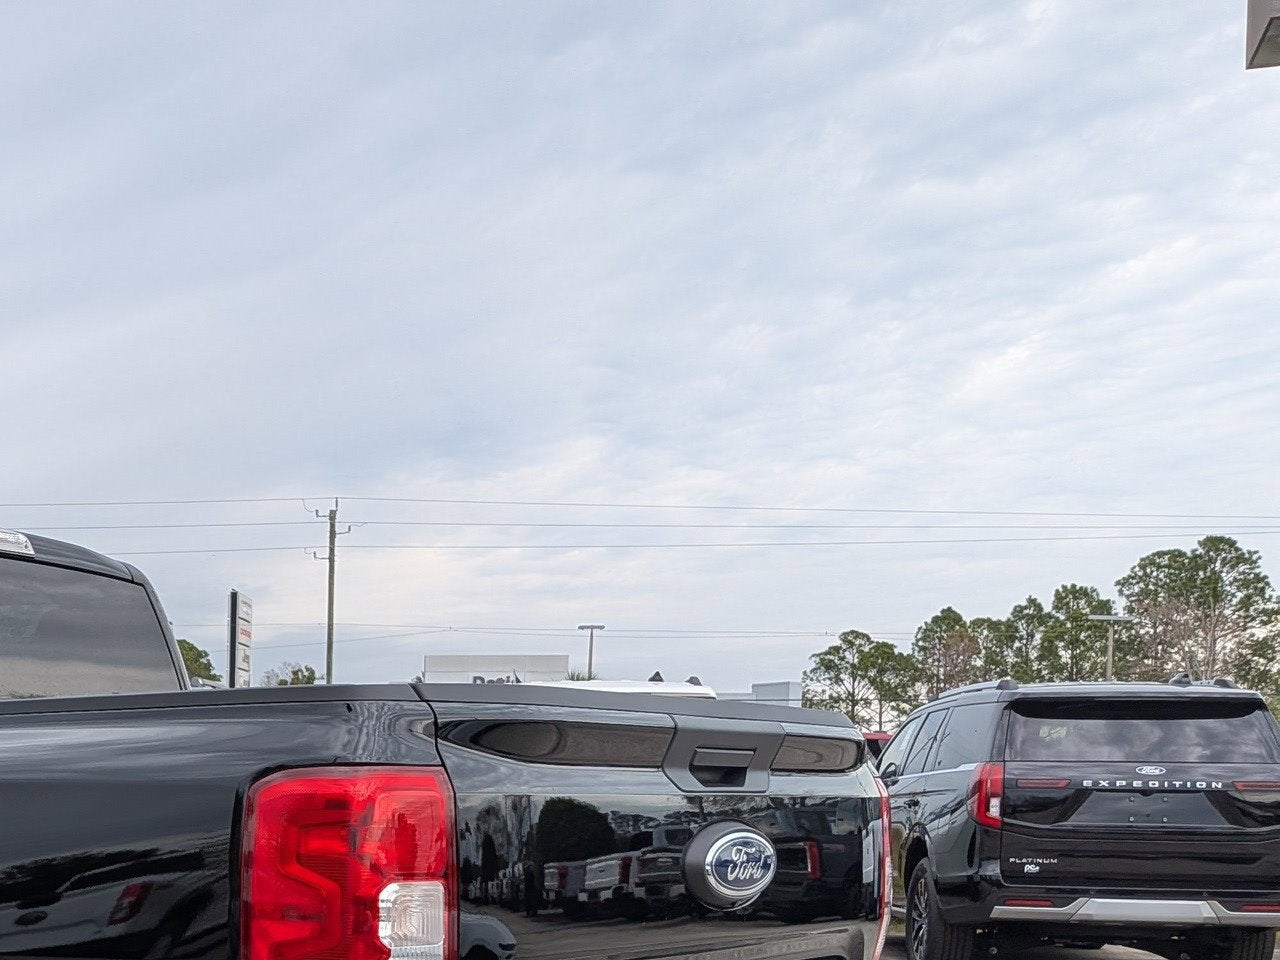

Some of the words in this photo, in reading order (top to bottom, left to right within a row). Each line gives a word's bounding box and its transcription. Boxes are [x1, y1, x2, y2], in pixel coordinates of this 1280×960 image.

[1140, 766, 1162, 775] Ford
[1082, 780, 1223, 789] EXPEDITION
[727, 845, 765, 881] Ford
